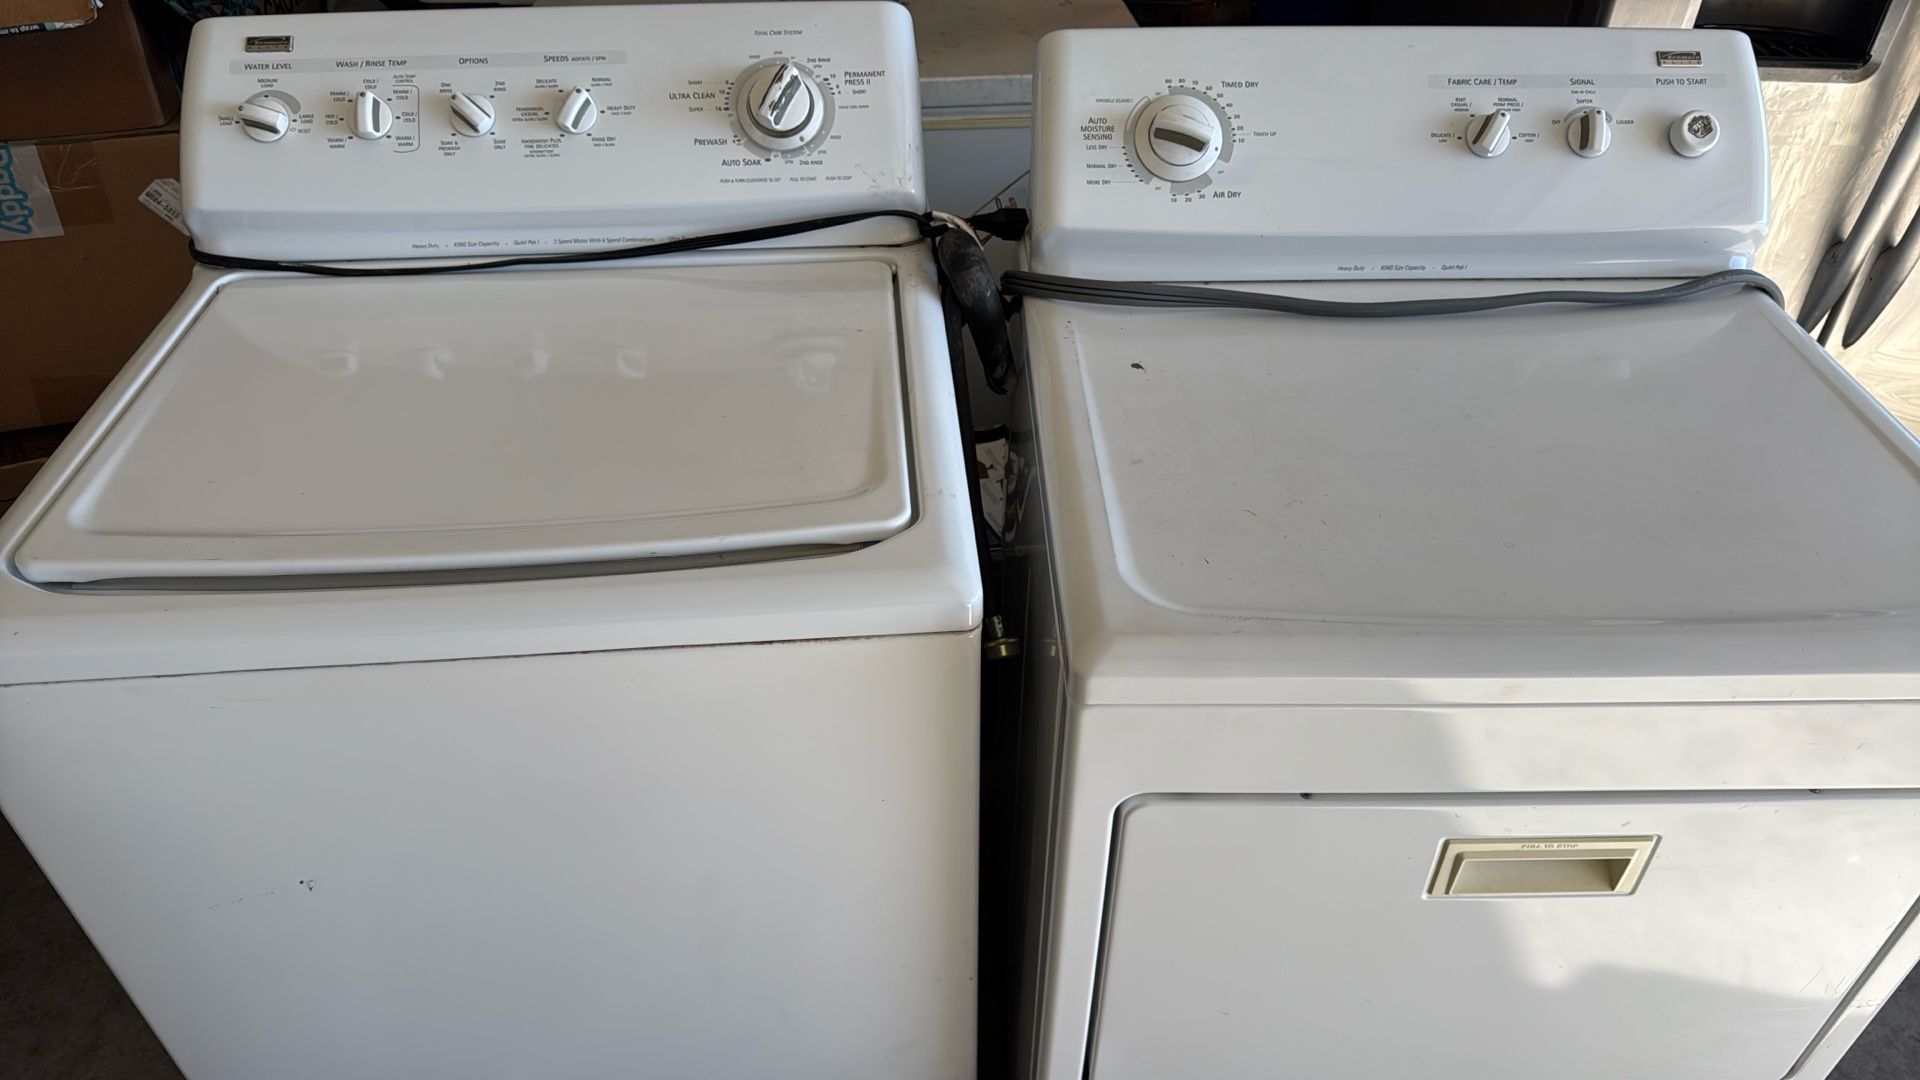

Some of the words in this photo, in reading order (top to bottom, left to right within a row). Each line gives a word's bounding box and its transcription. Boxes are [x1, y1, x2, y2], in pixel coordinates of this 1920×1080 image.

[20, 24, 40, 32] wrap
[336, 60, 359, 68] WASH
[844, 70, 885, 78] PERMANENT
[1221, 80, 1243, 88] TIMED
[1245, 80, 1259, 88] DRY
[1448, 78, 1472, 86] FABRIC
[1474, 78, 1492, 86] CARE
[1498, 78, 1517, 86] TEMP
[669, 92, 691, 100] ULTRA
[722, 159, 740, 167] AUTO
